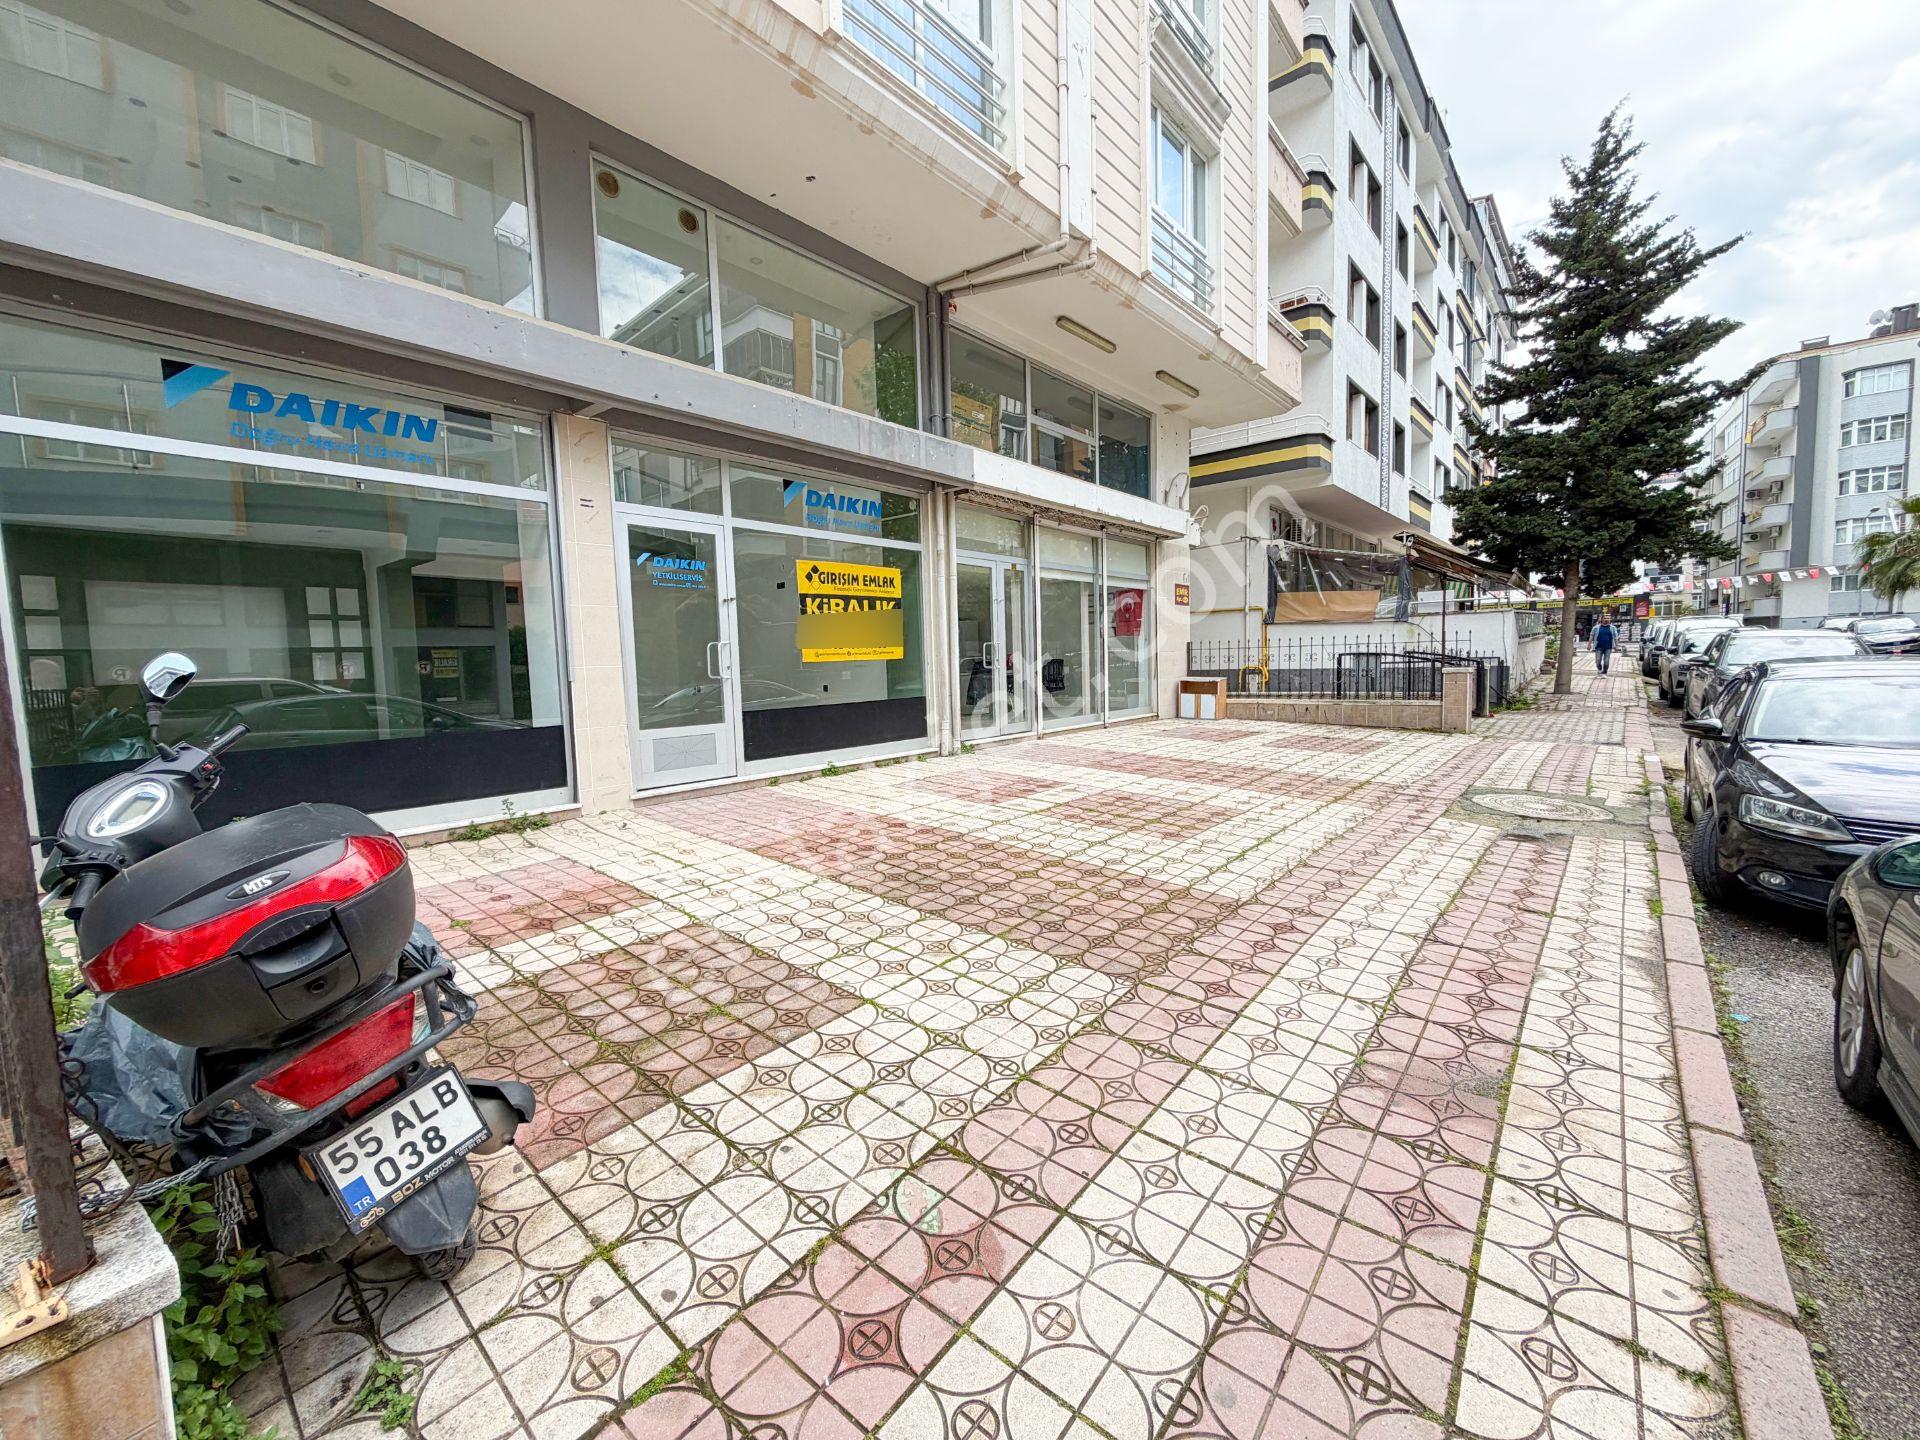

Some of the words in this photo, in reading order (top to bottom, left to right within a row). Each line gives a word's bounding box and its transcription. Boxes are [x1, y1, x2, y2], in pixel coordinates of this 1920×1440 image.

[228, 382, 437, 443] DAIKIN
[805, 489, 882, 518] DAIKIN
[652, 556, 707, 571] DAIKIN
[862, 574, 896, 589] EMLAK
[242, 873, 273, 895] MTS
[328, 1126, 384, 1174] 55
[391, 1079, 459, 1139] ALB
[373, 1125, 447, 1187] 038
[390, 1176, 424, 1204] BOZ
[424, 1156, 455, 1182] MOTOR
[353, 1196, 374, 1211] TR
